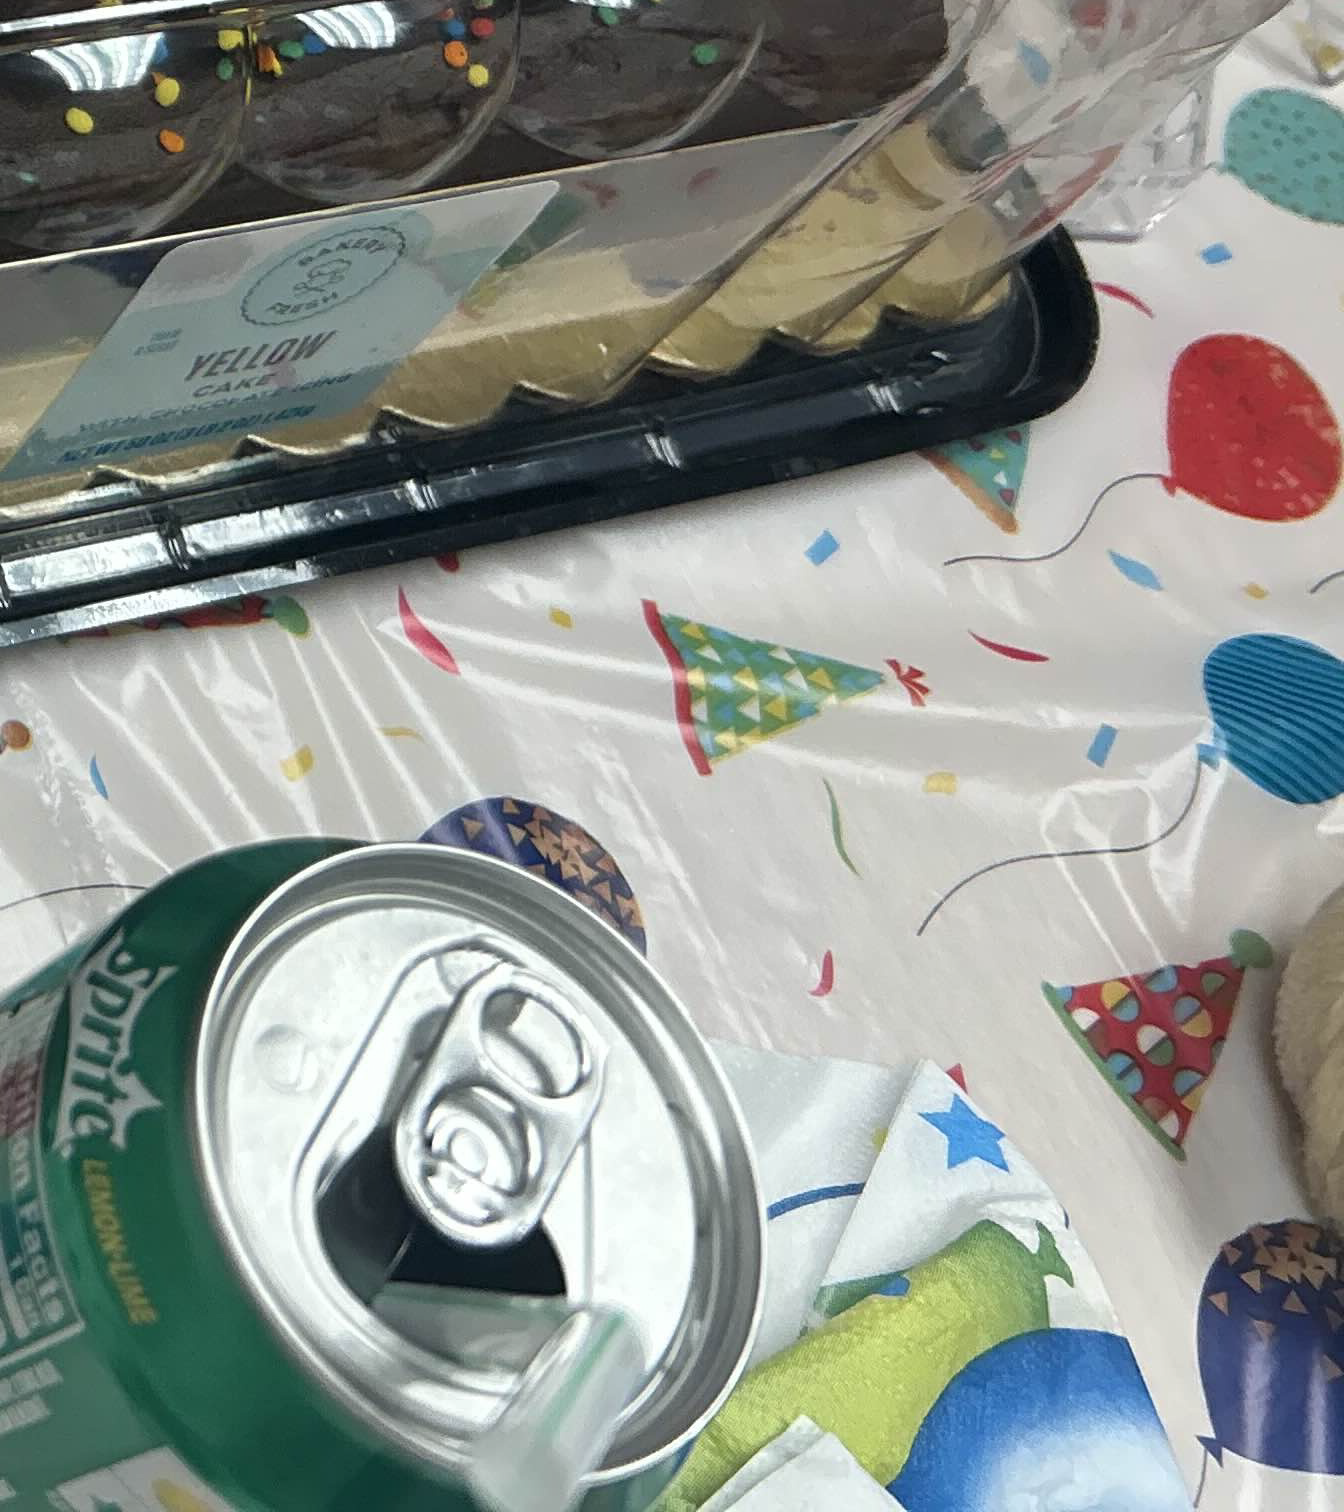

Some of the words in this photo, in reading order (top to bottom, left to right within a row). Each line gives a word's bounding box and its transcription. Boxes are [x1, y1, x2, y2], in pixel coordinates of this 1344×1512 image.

[184, 330, 338, 381] YELLOW
[193, 373, 276, 398] CAKE
[66, 942, 162, 1143] Sprite
[82, 1159, 158, 1327] LEMON-LIME
